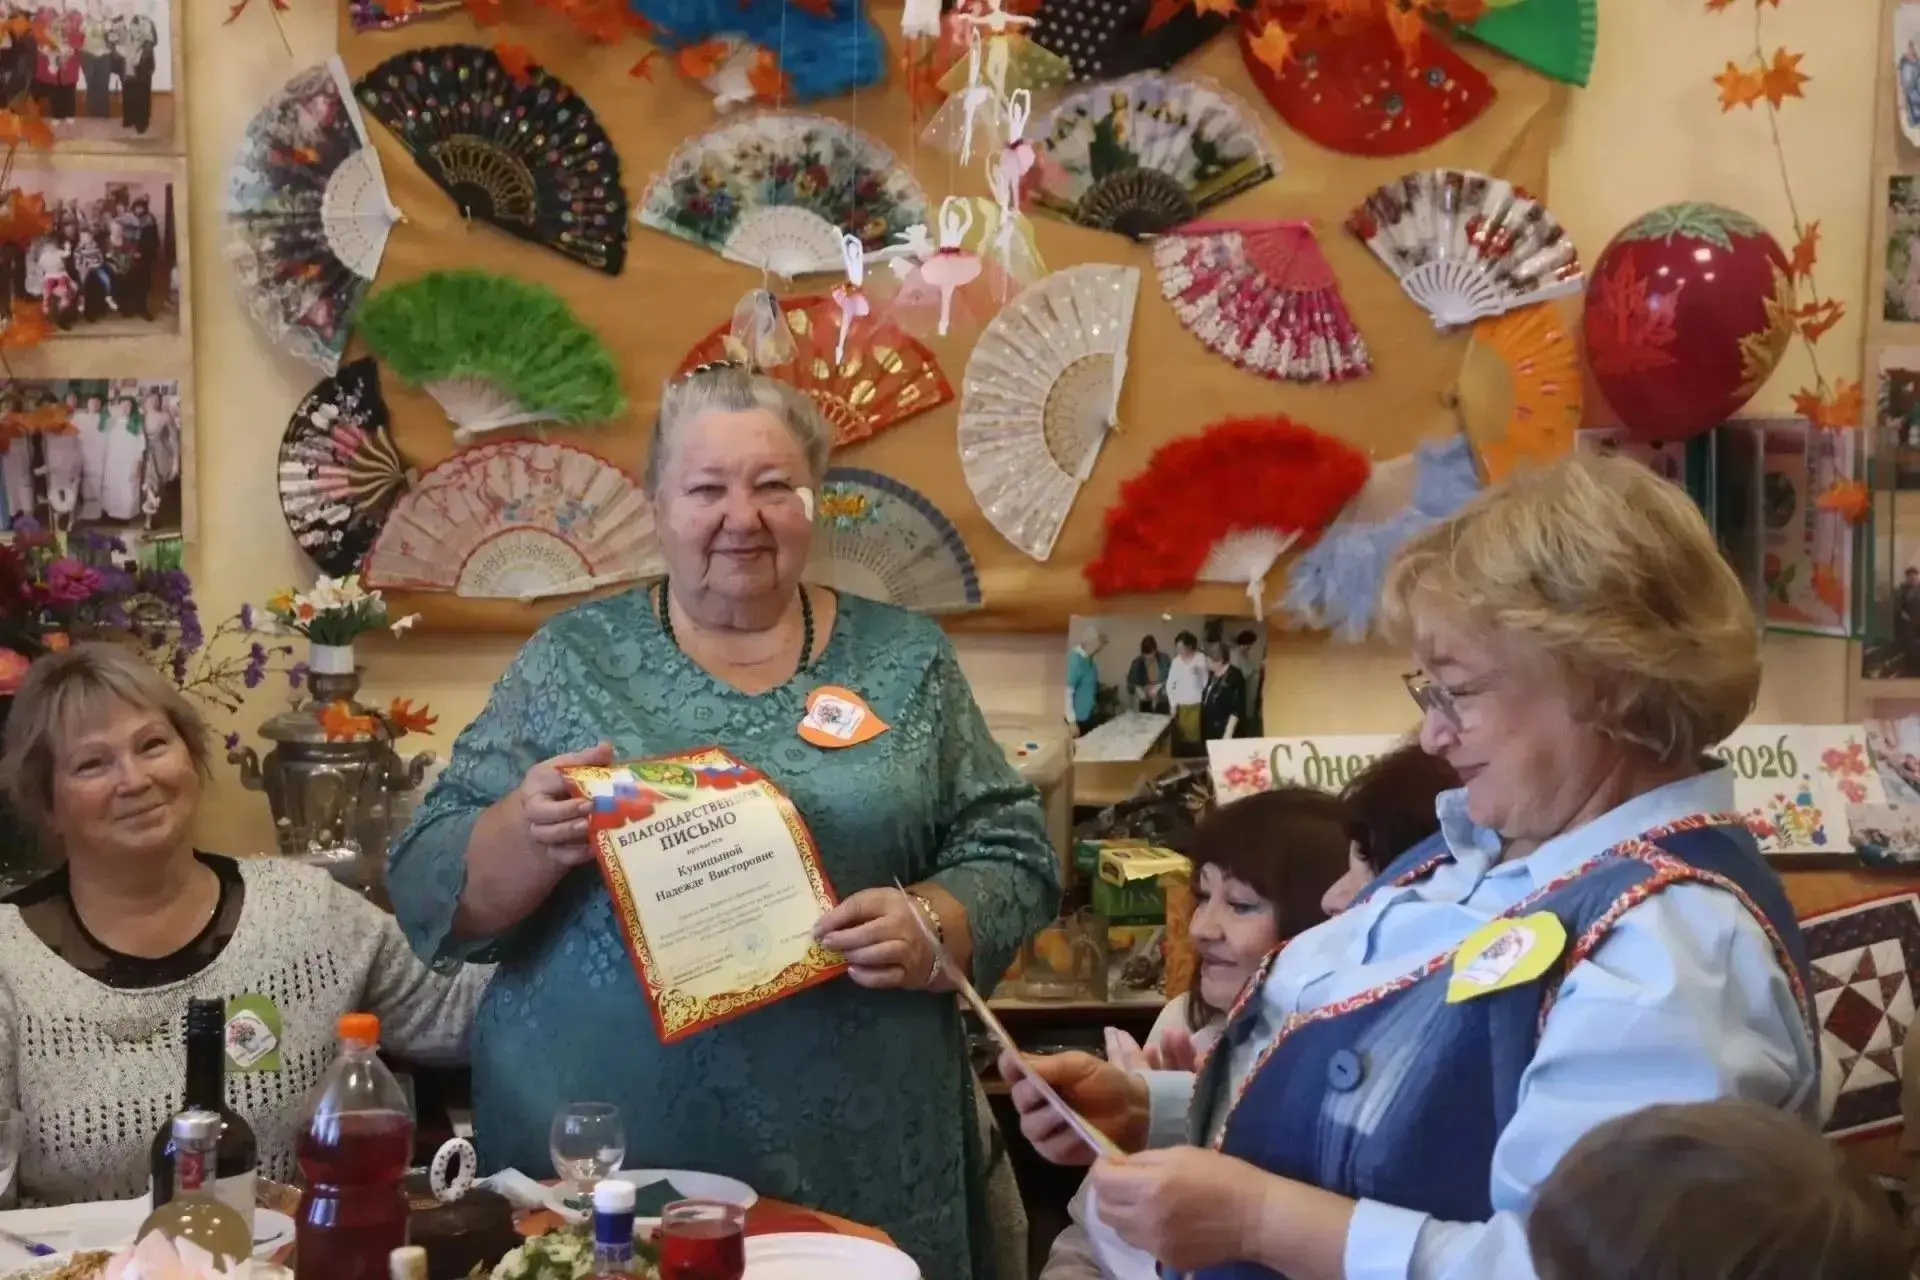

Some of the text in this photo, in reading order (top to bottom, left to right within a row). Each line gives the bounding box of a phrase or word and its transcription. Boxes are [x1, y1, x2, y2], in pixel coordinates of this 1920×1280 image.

[1270, 743, 1293, 788] С
[1718, 735, 1798, 779] 2026
[618, 788, 761, 848] БЛАГОДАРСТВЕНЕ
[659, 811, 737, 851] ПИСЬМО
[655, 877, 704, 902] Надежде
[708, 849, 774, 882] Викторовне
[677, 843, 743, 877] Куницыной
